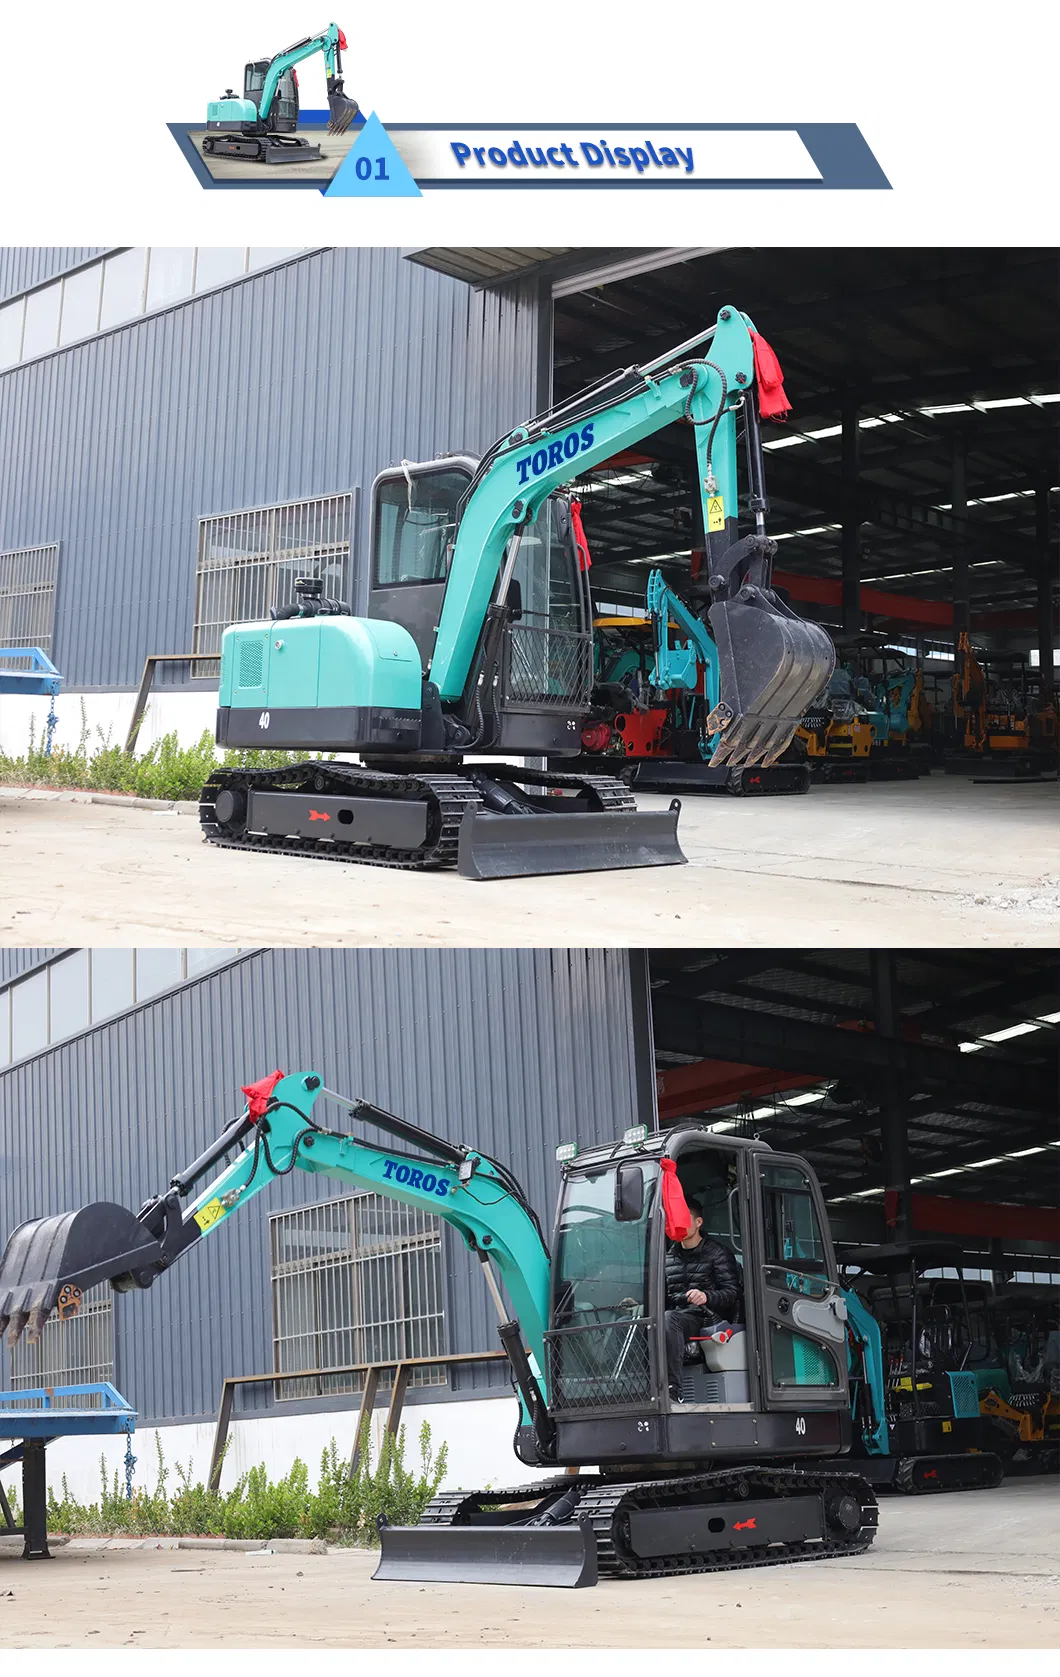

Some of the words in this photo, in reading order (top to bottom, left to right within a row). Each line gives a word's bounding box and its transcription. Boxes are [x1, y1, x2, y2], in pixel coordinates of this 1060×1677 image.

[516, 422, 594, 486] TOROS
[258, 711, 270, 730] 40
[382, 1159, 450, 1197] TOROS
[795, 1417, 806, 1435] 40
